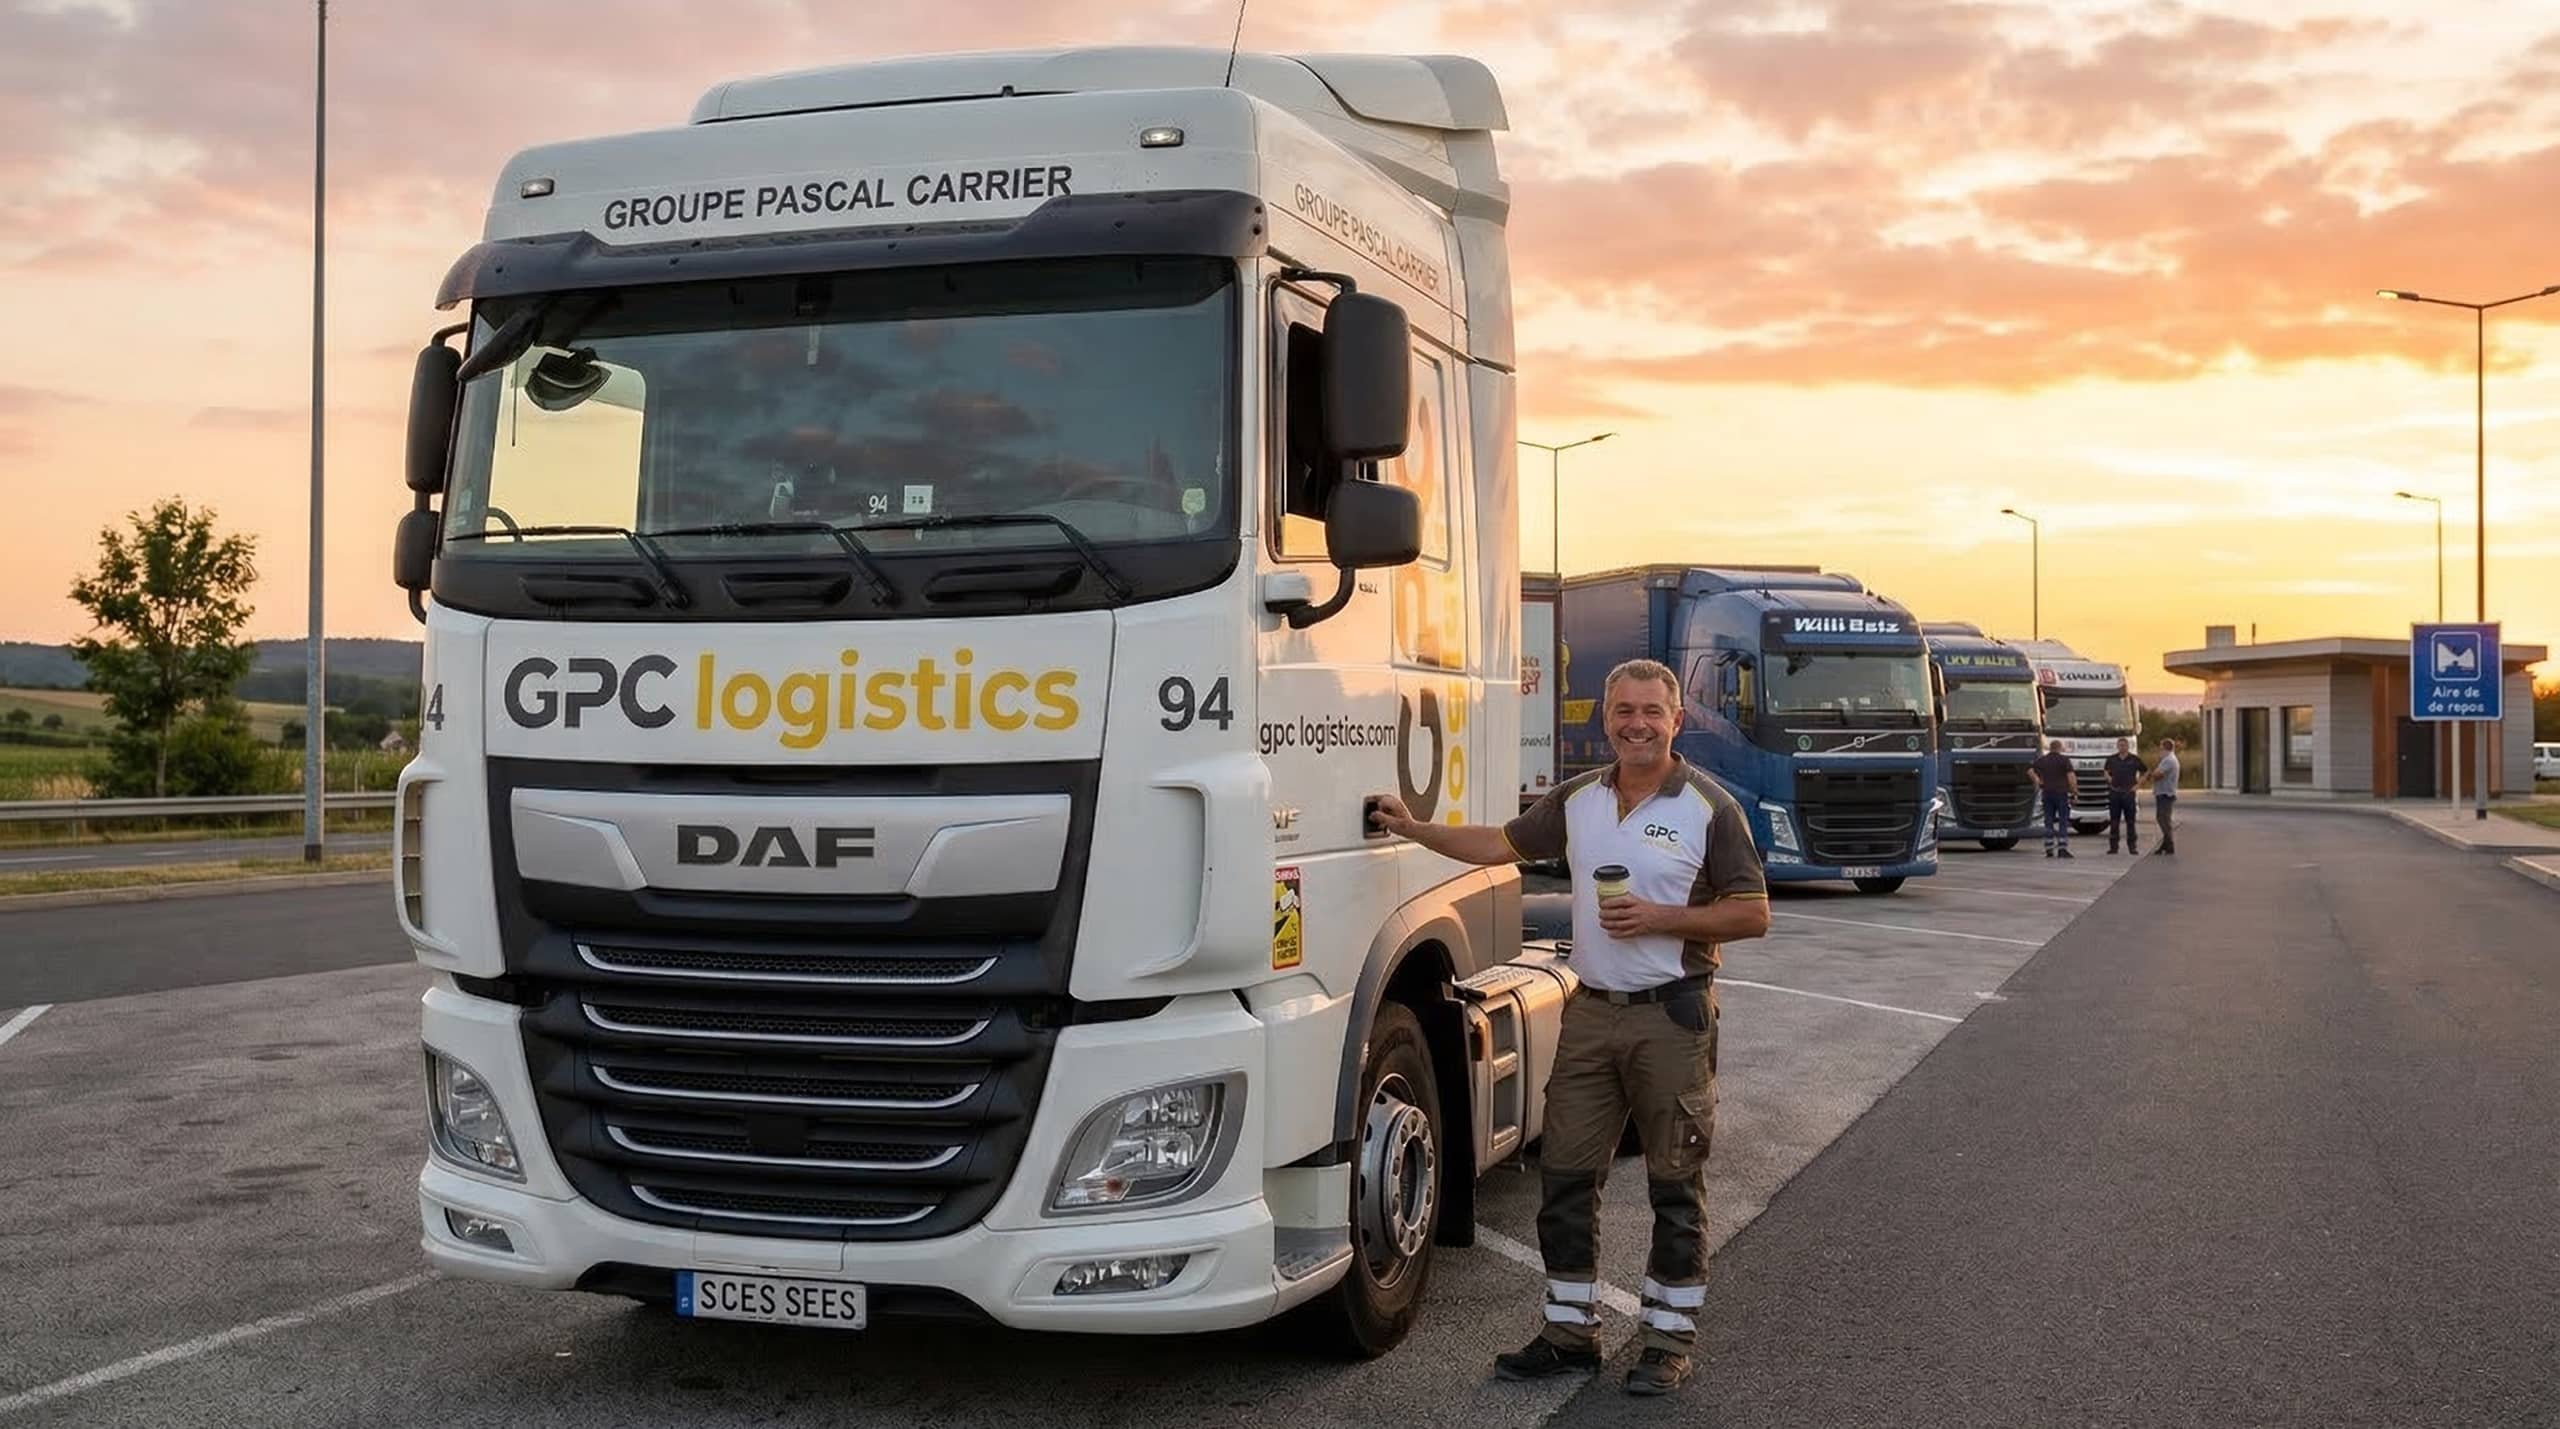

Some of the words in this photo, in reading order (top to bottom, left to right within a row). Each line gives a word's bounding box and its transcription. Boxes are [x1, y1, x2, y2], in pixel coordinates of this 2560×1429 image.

[604, 187, 745, 231] GROUPE
[755, 178, 895, 218] PASCAL
[905, 165, 1074, 206] CARRIER
[1294, 183, 1349, 238] GROUPE
[1351, 216, 1396, 266] PASCAL
[868, 493, 888, 514] 94
[504, 654, 678, 730] GPC
[697, 648, 1081, 749] logistics
[1158, 676, 1235, 731] 94
[2428, 701, 2444, 713] de
[2448, 703, 2485, 715] repos
[2432, 685, 2460, 699] Aire
[1260, 722, 1296, 755] gpc
[1300, 714, 1397, 755] logistics.com
[677, 824, 876, 868] DAF
[1644, 823, 1679, 843] GPC
[700, 1280, 777, 1315] SCES
[785, 1286, 857, 1321] SEES
